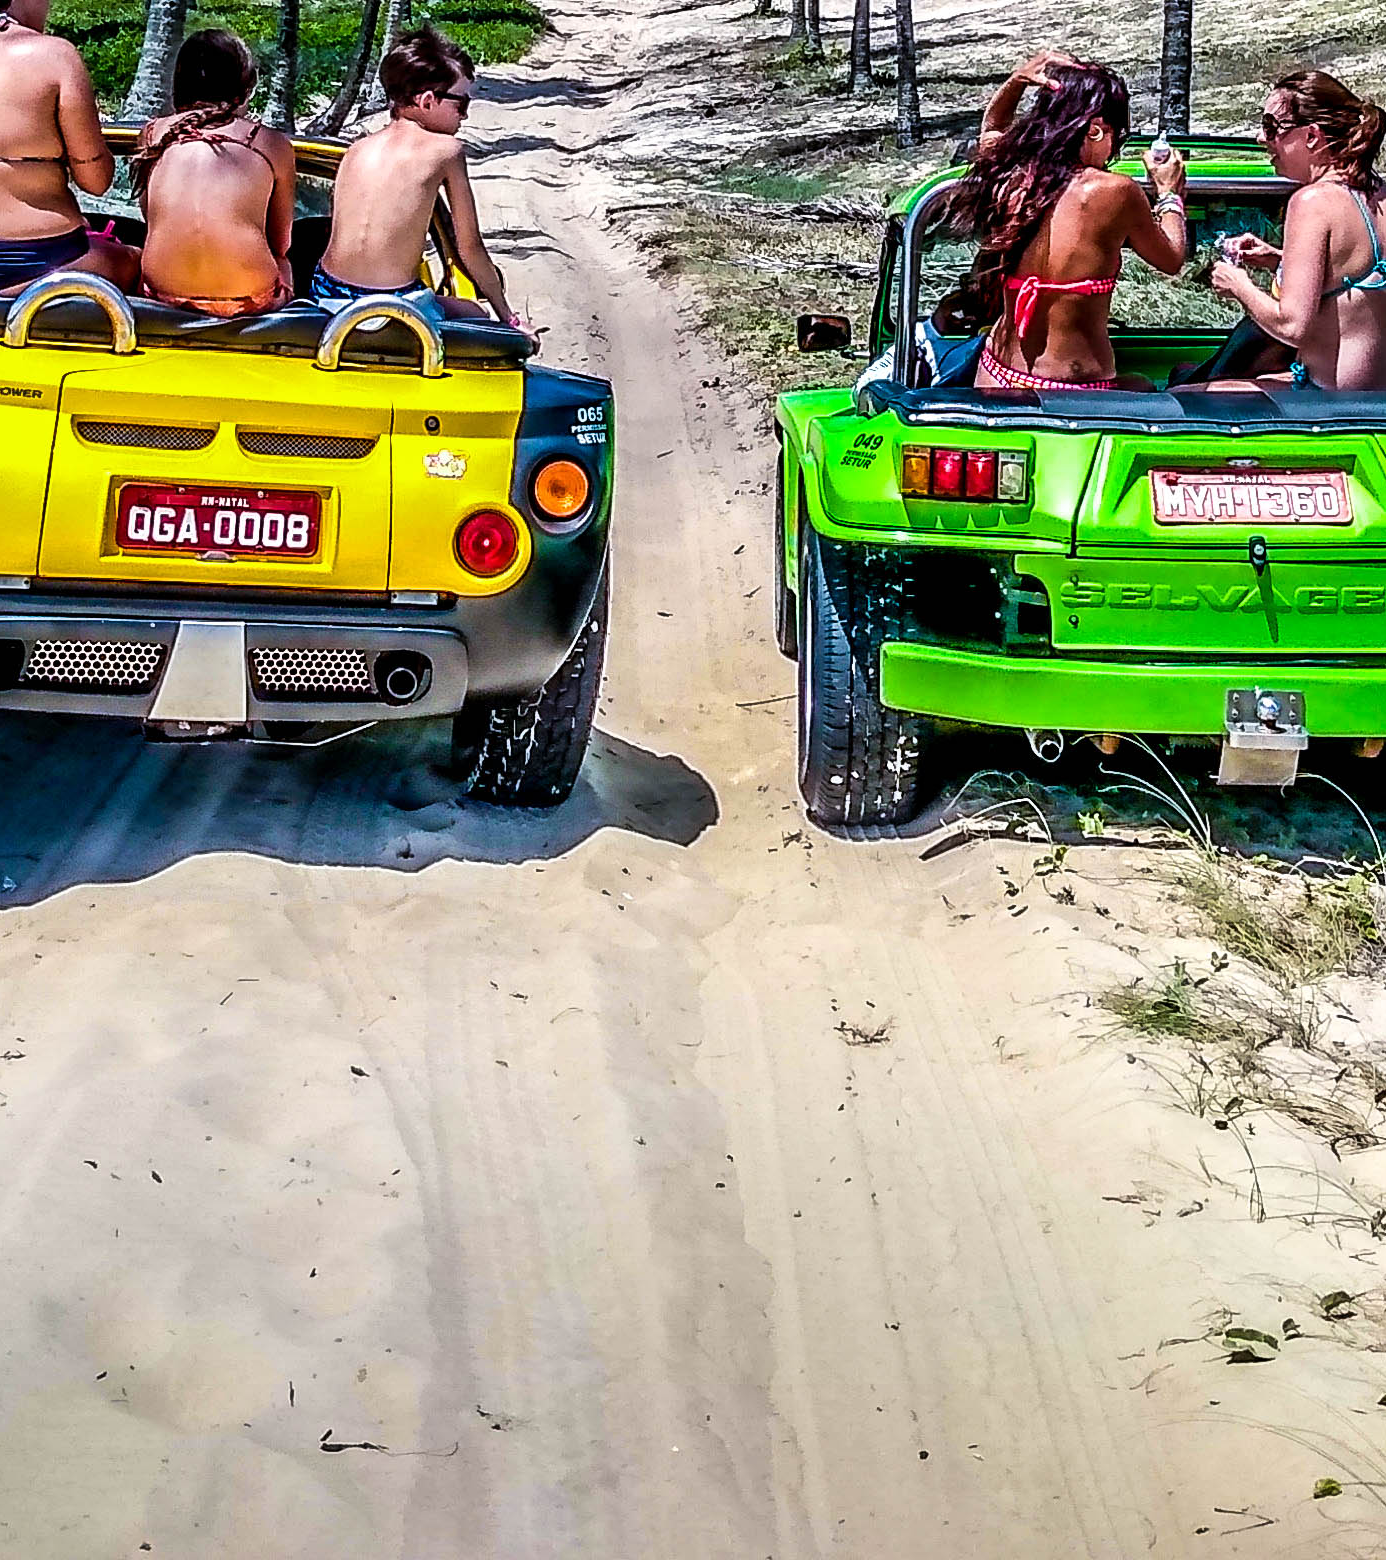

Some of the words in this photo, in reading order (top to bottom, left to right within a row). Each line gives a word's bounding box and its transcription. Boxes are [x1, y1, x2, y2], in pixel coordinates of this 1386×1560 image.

[577, 406, 603, 422] 065
[853, 433, 884, 450] 049
[840, 455, 871, 469] SETUR
